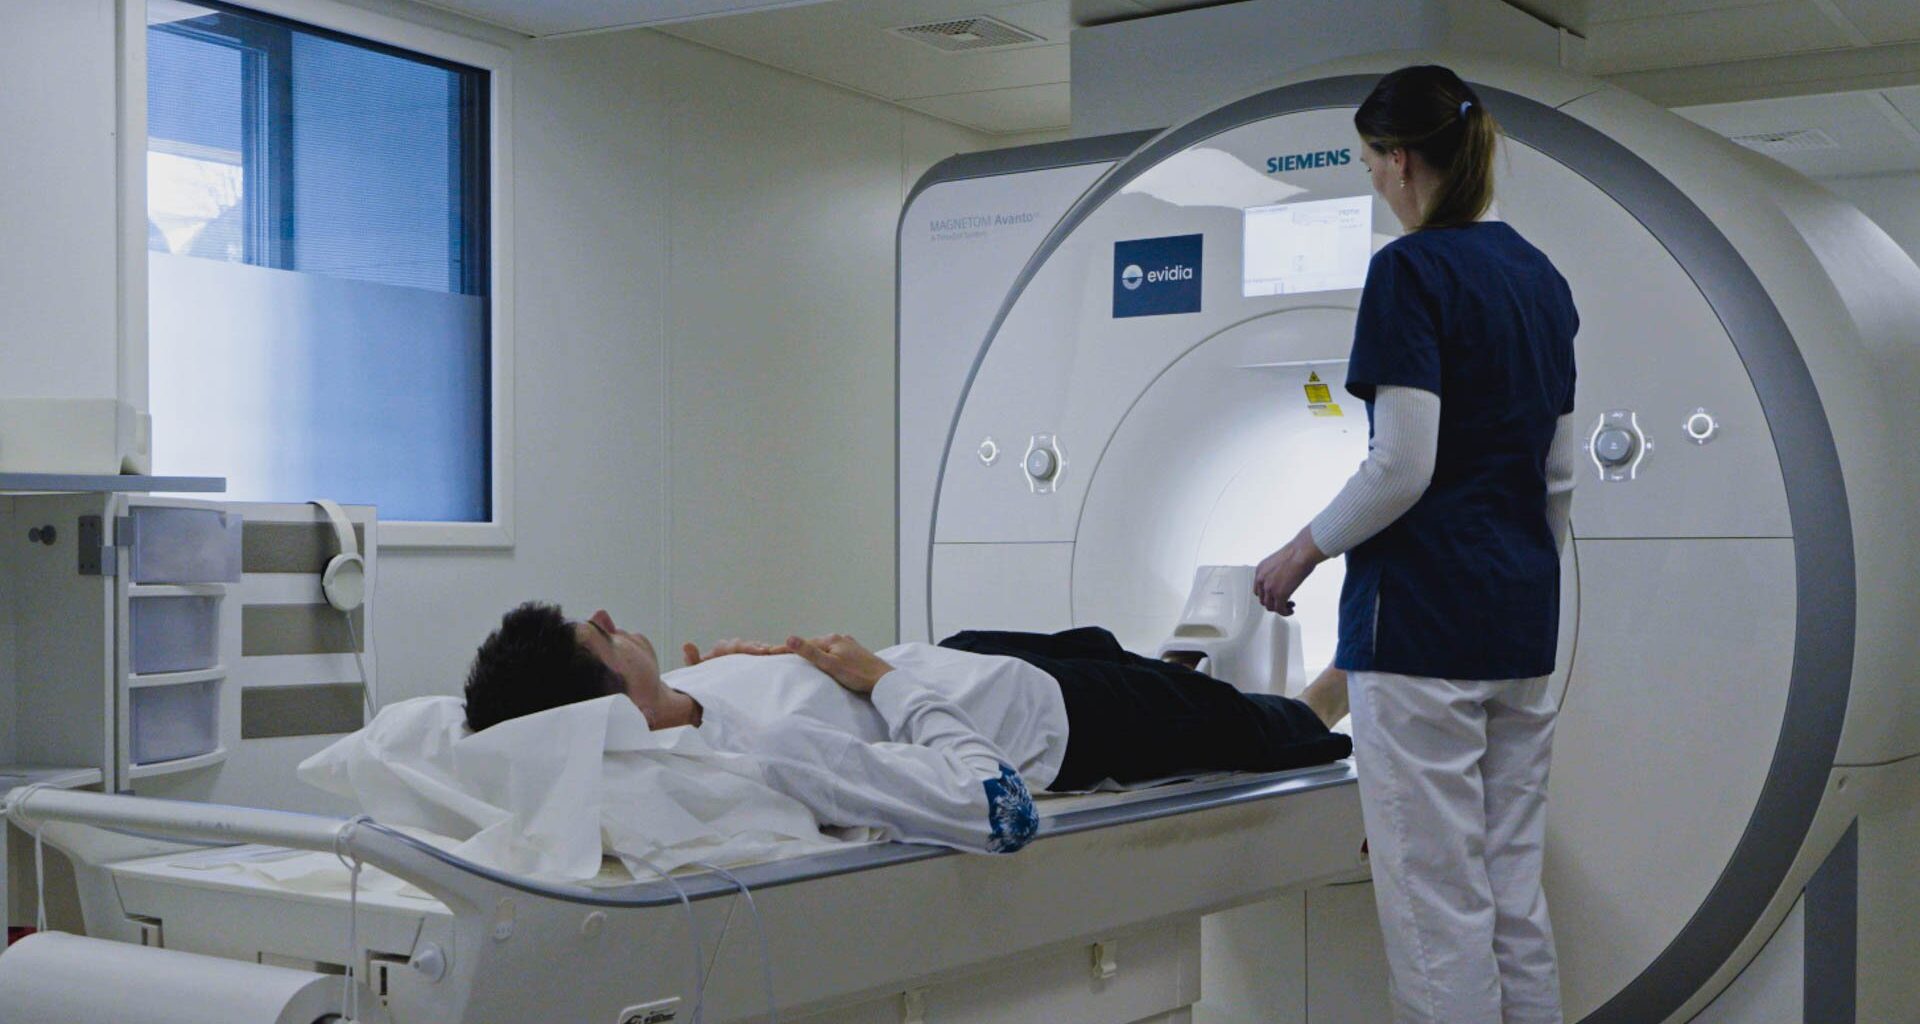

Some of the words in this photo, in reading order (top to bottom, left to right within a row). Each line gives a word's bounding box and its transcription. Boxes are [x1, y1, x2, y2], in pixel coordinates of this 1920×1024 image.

[1267, 148, 1351, 174] SIEMENS
[929, 215, 992, 232] MAGNETOM
[994, 212, 1034, 226] Avanto
[1147, 264, 1193, 283] evidia
